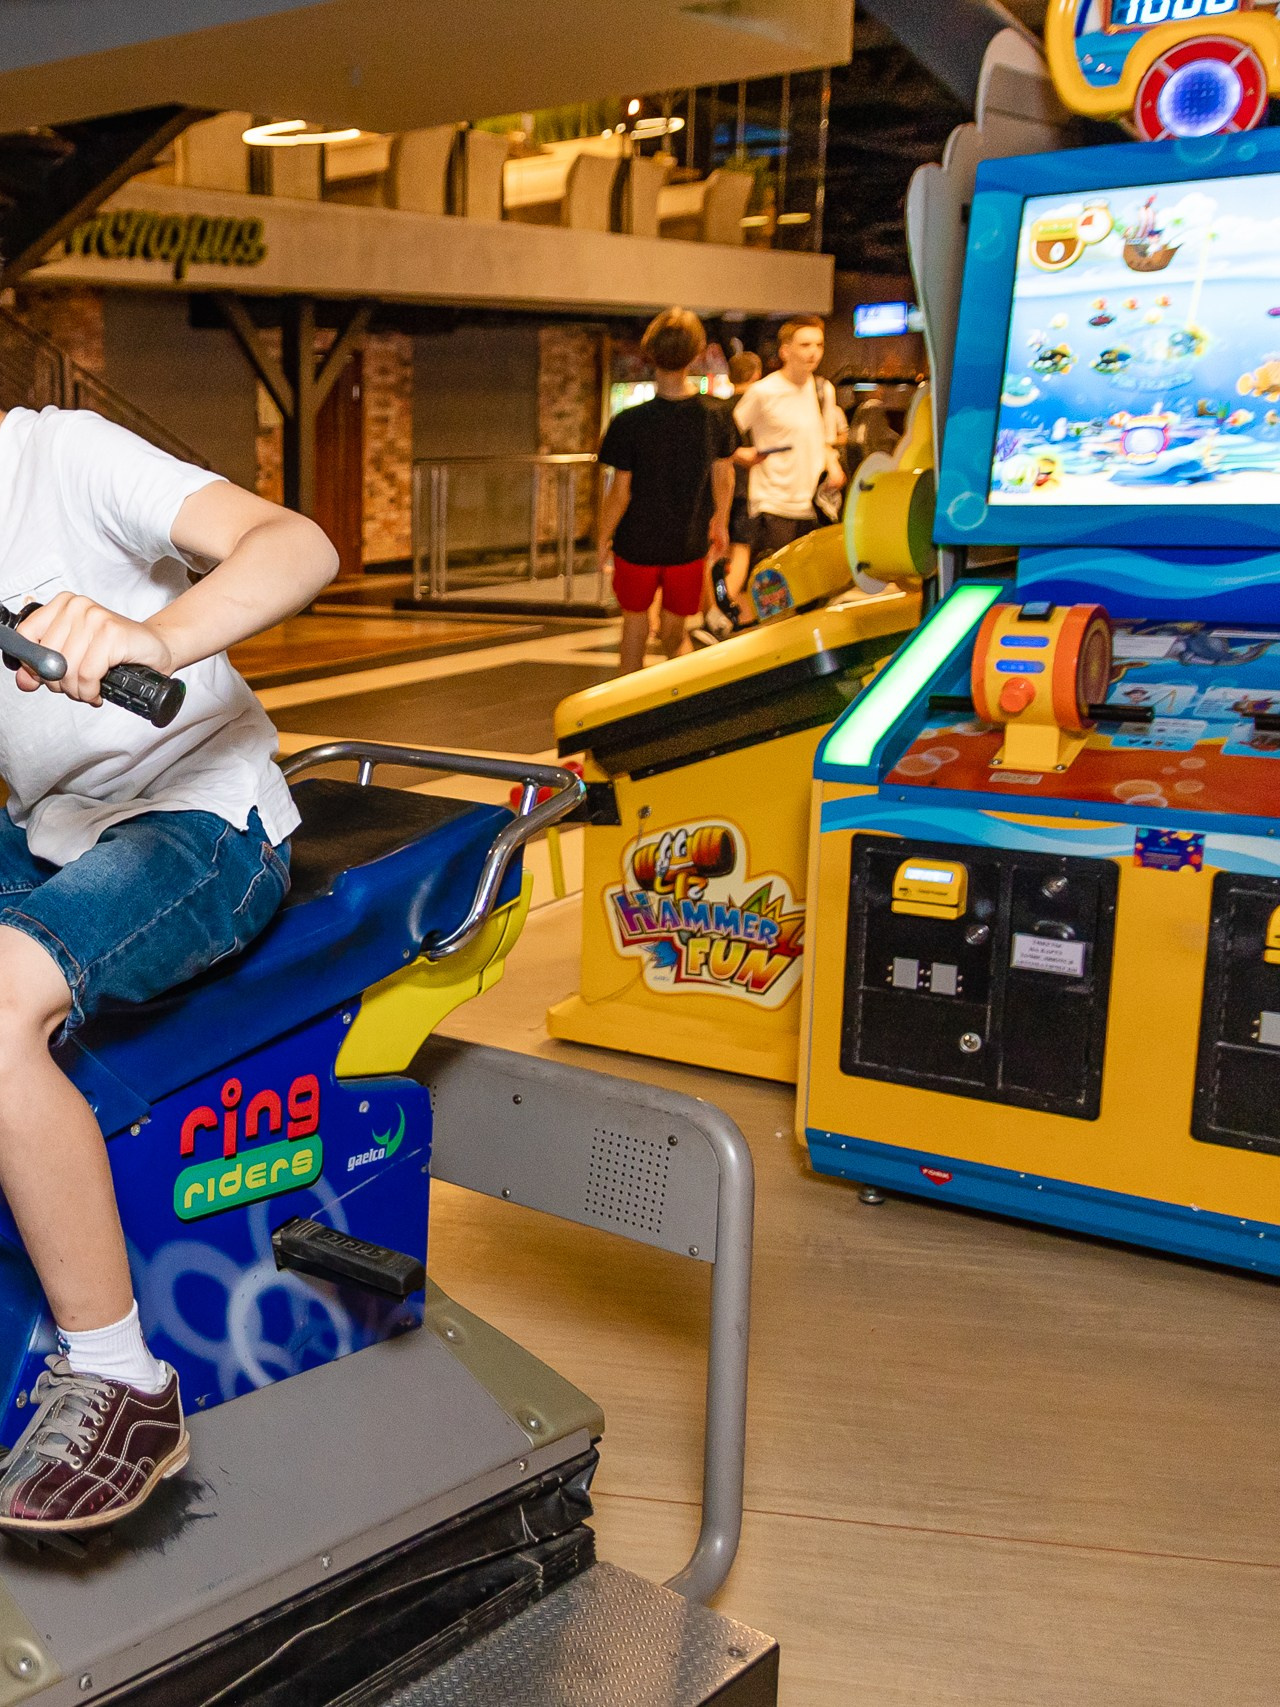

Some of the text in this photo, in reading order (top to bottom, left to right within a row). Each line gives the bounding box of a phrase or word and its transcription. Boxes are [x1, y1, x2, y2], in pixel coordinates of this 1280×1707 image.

[612, 890, 779, 947] HAMMER
[685, 937, 794, 995] FUN
[180, 1074, 320, 1156] ring
[184, 1149, 313, 1208] riders
[347, 1147, 386, 1172] gaelco
